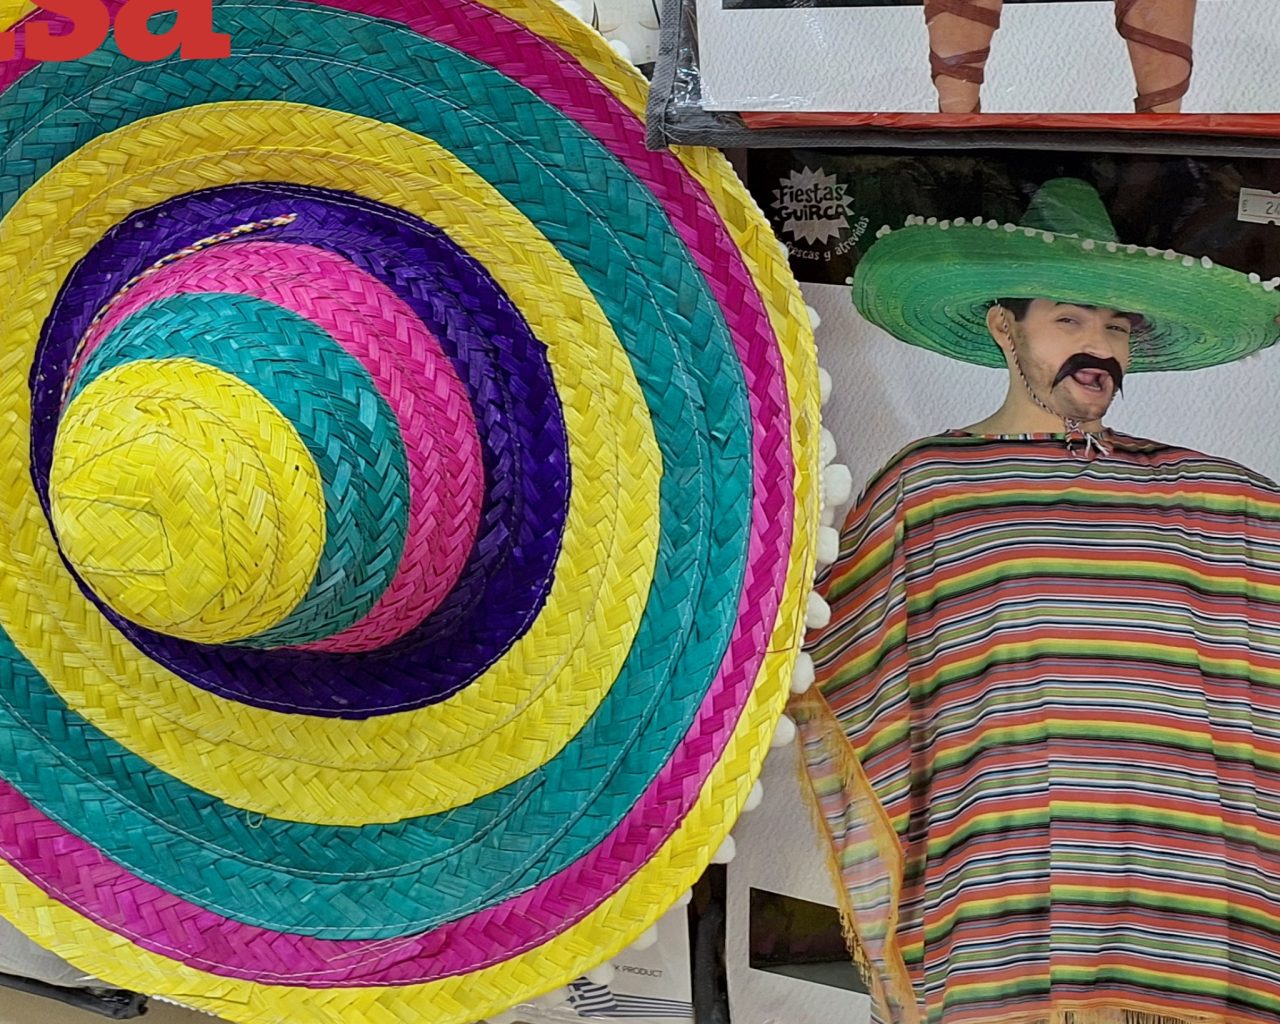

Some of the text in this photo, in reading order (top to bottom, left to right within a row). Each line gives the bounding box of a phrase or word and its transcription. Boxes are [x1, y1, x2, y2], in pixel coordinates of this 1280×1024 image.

[780, 183, 844, 204] Fiestas
[835, 216, 870, 256] atrevidas
[622, 965, 663, 978] PRODUCT
